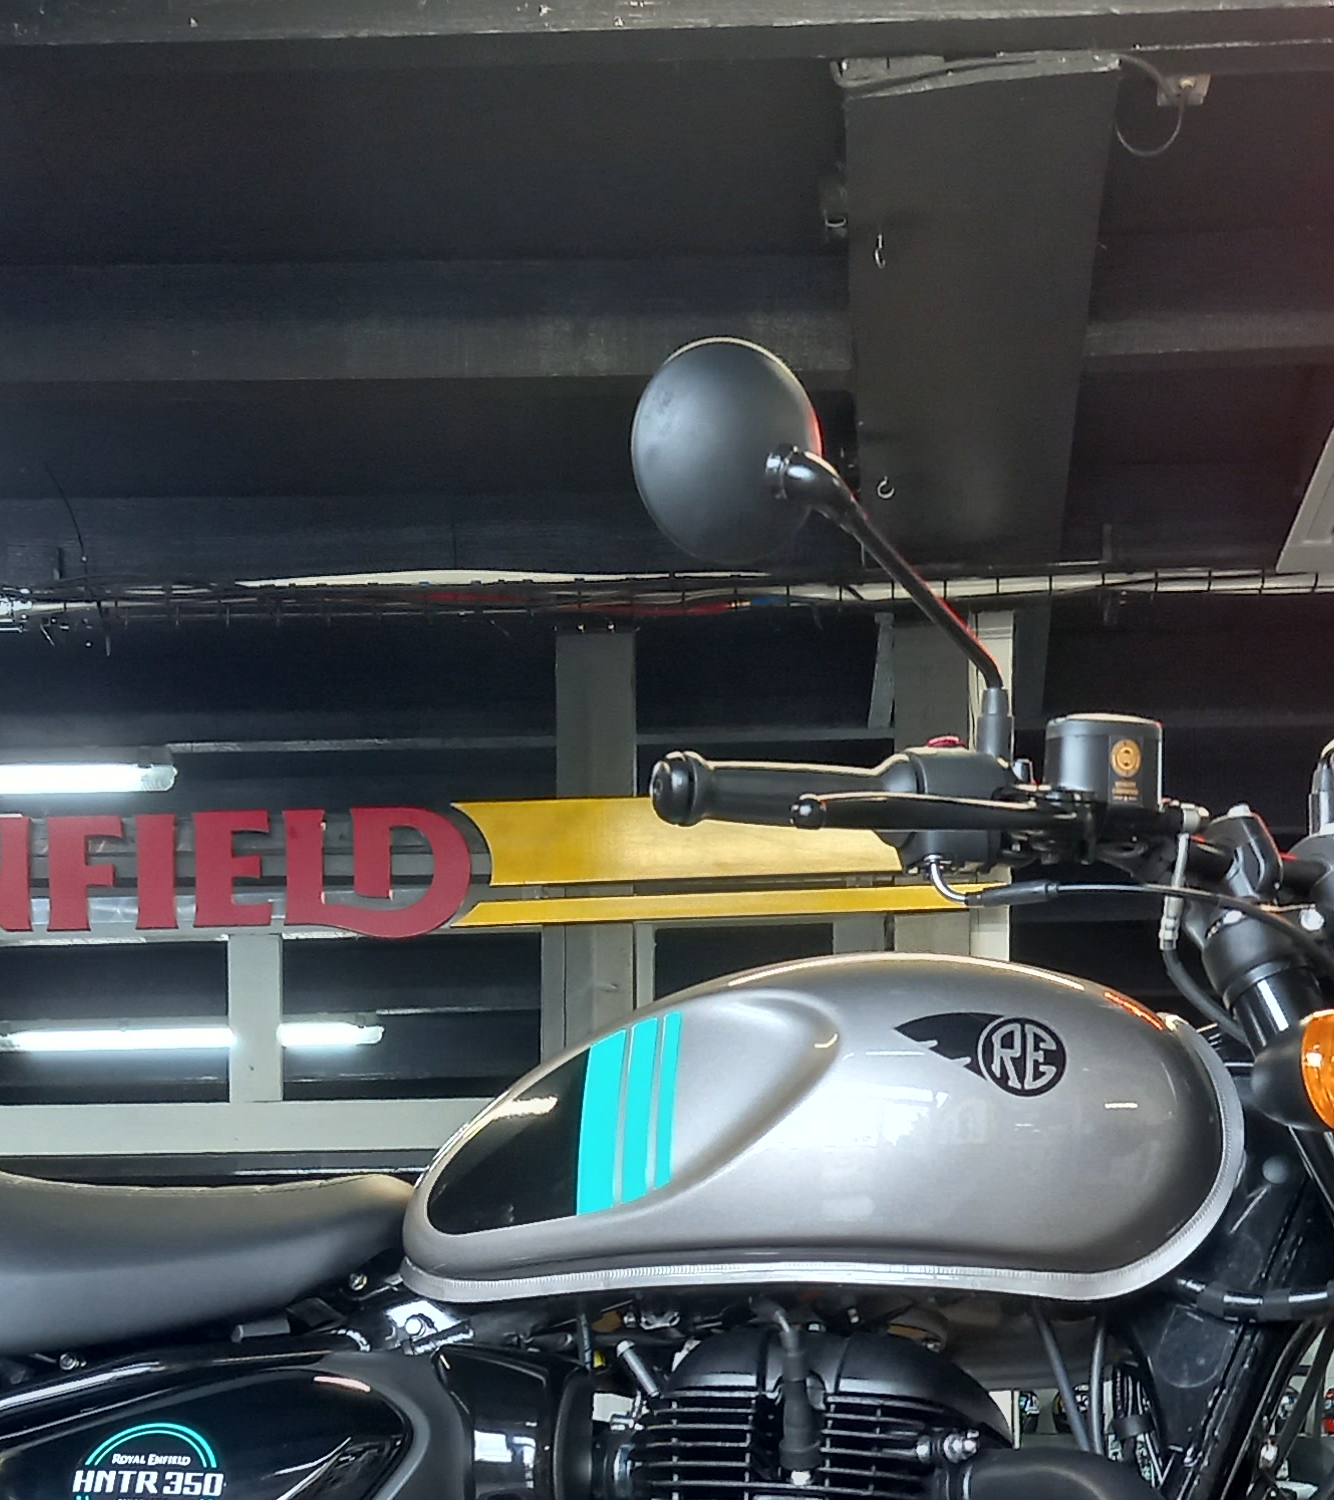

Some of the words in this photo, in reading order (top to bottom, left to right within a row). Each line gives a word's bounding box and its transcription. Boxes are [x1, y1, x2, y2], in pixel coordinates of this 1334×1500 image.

[991, 1021, 1058, 1090] RE
[112, 1453, 146, 1466] ROYAL
[148, 1453, 191, 1466] ENFIELD
[72, 1470, 157, 1495] HNTR
[162, 1472, 224, 1497] 350
